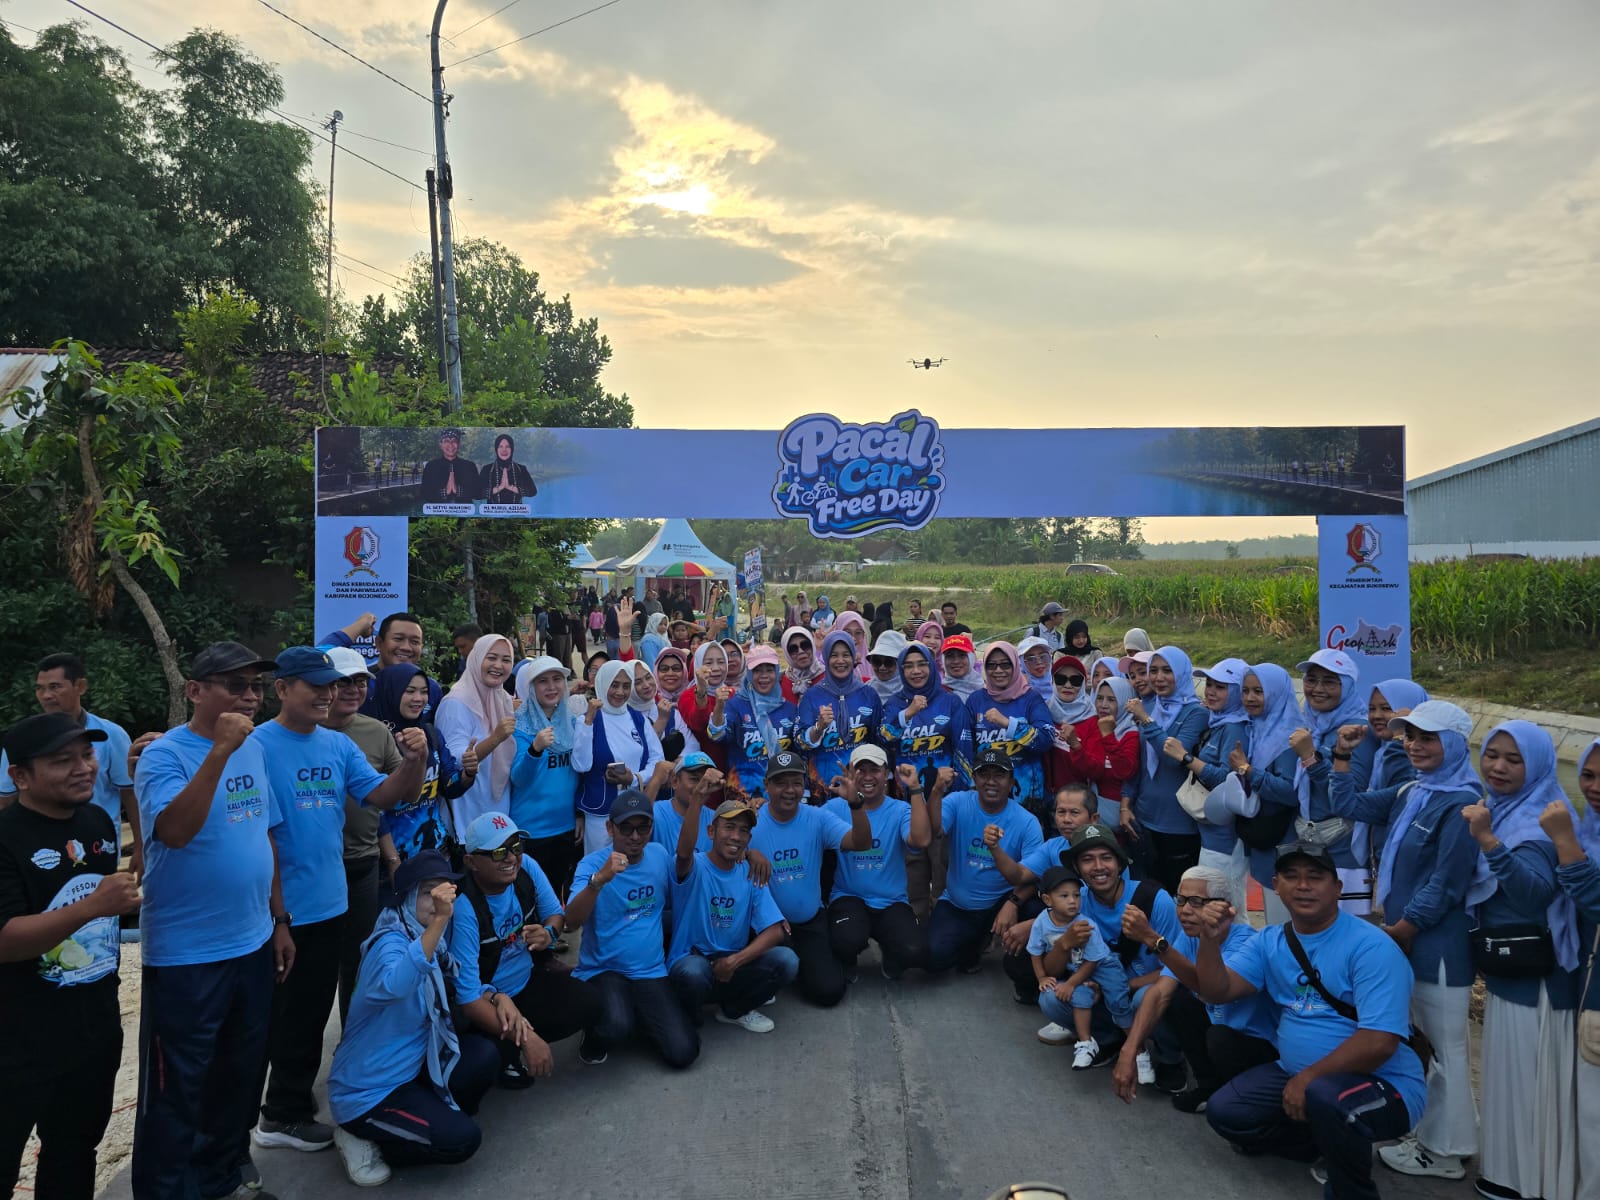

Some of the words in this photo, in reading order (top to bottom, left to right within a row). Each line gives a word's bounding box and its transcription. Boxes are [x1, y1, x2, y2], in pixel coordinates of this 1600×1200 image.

[786, 418, 931, 475] Pacal
[839, 458, 912, 494] Car
[816, 494, 875, 524] Free
[879, 488, 930, 517] Day
[901, 724, 939, 740] ACAL
[901, 735, 945, 752] CFD
[548, 752, 573, 769] BM
[297, 767, 332, 782] CFD
[225, 774, 254, 793] CFD
[773, 848, 799, 862] CFD
[71, 881, 97, 895] PESON
[627, 885, 654, 902] CFD
[710, 896, 735, 909] CFD
